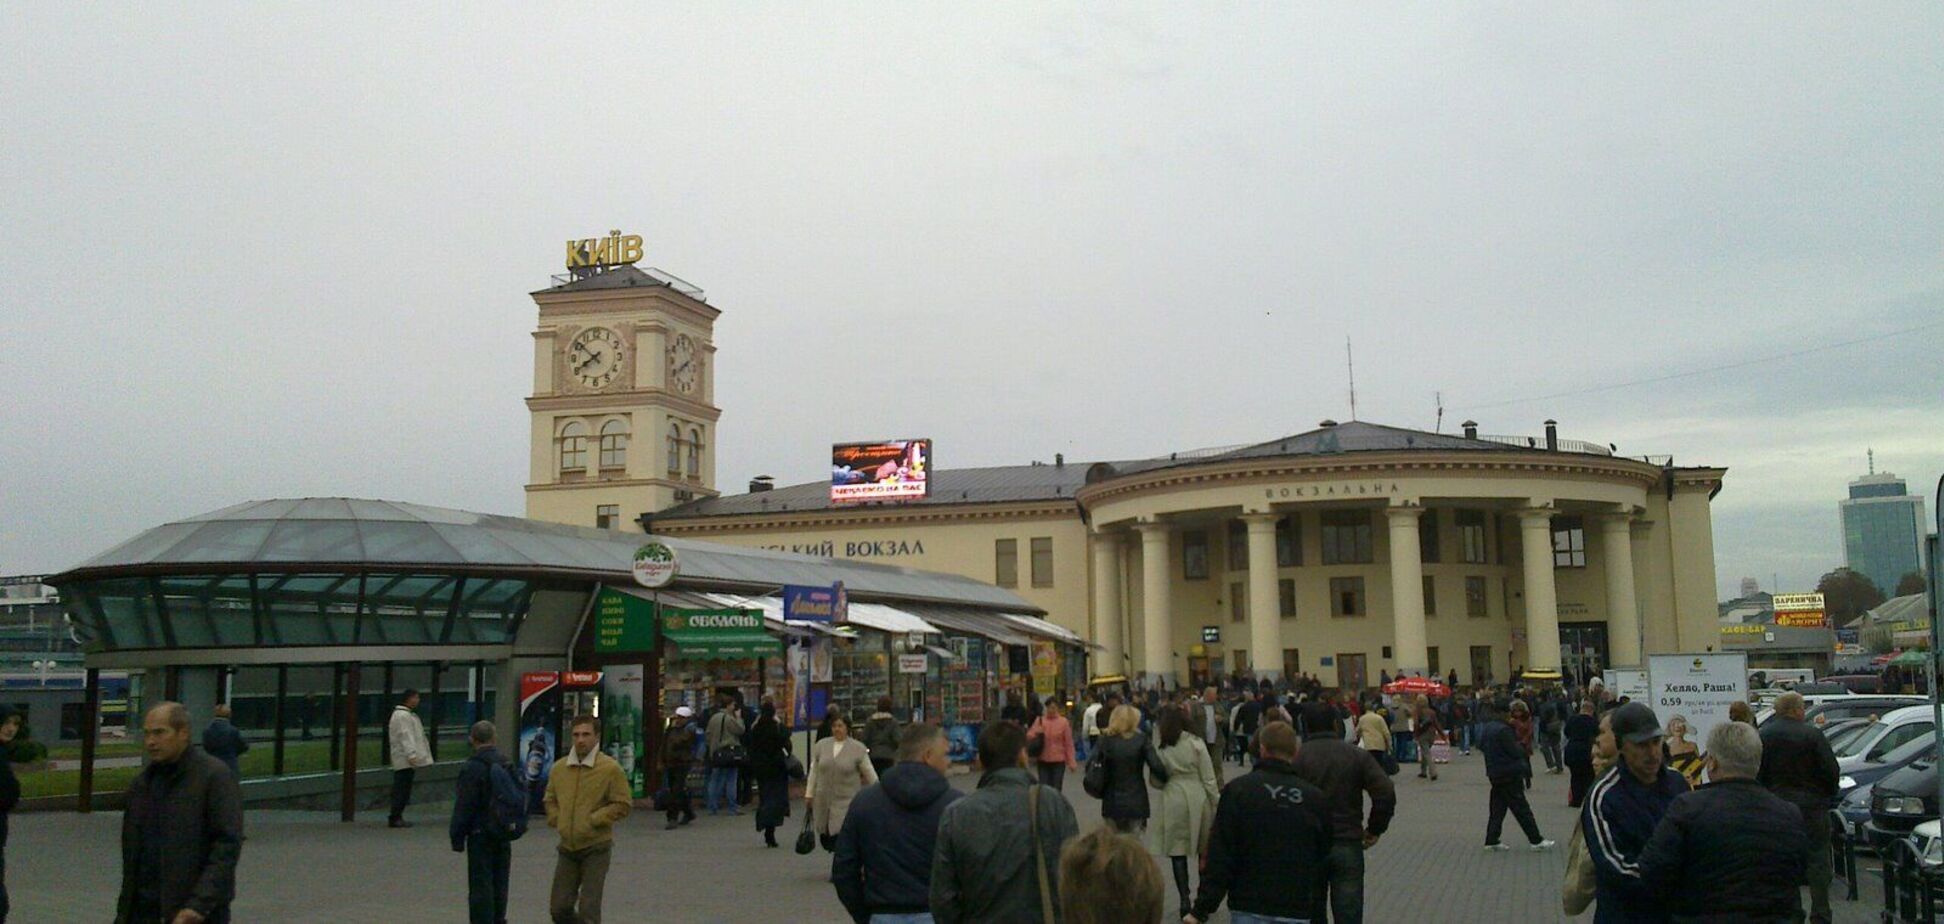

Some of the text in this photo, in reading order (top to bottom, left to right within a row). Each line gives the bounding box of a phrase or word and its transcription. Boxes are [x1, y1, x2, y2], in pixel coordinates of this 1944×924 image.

[566, 230, 644, 269] КИЇВ
[1265, 482, 1399, 499] ВОКЗАЛЬНА
[846, 540, 924, 557] ВОКЗАЛ
[688, 615, 759, 628] ОБОЛОНЬ
[1665, 682, 1736, 693] Хелло, Раша!
[1264, 783, 1303, 804] Y-3
